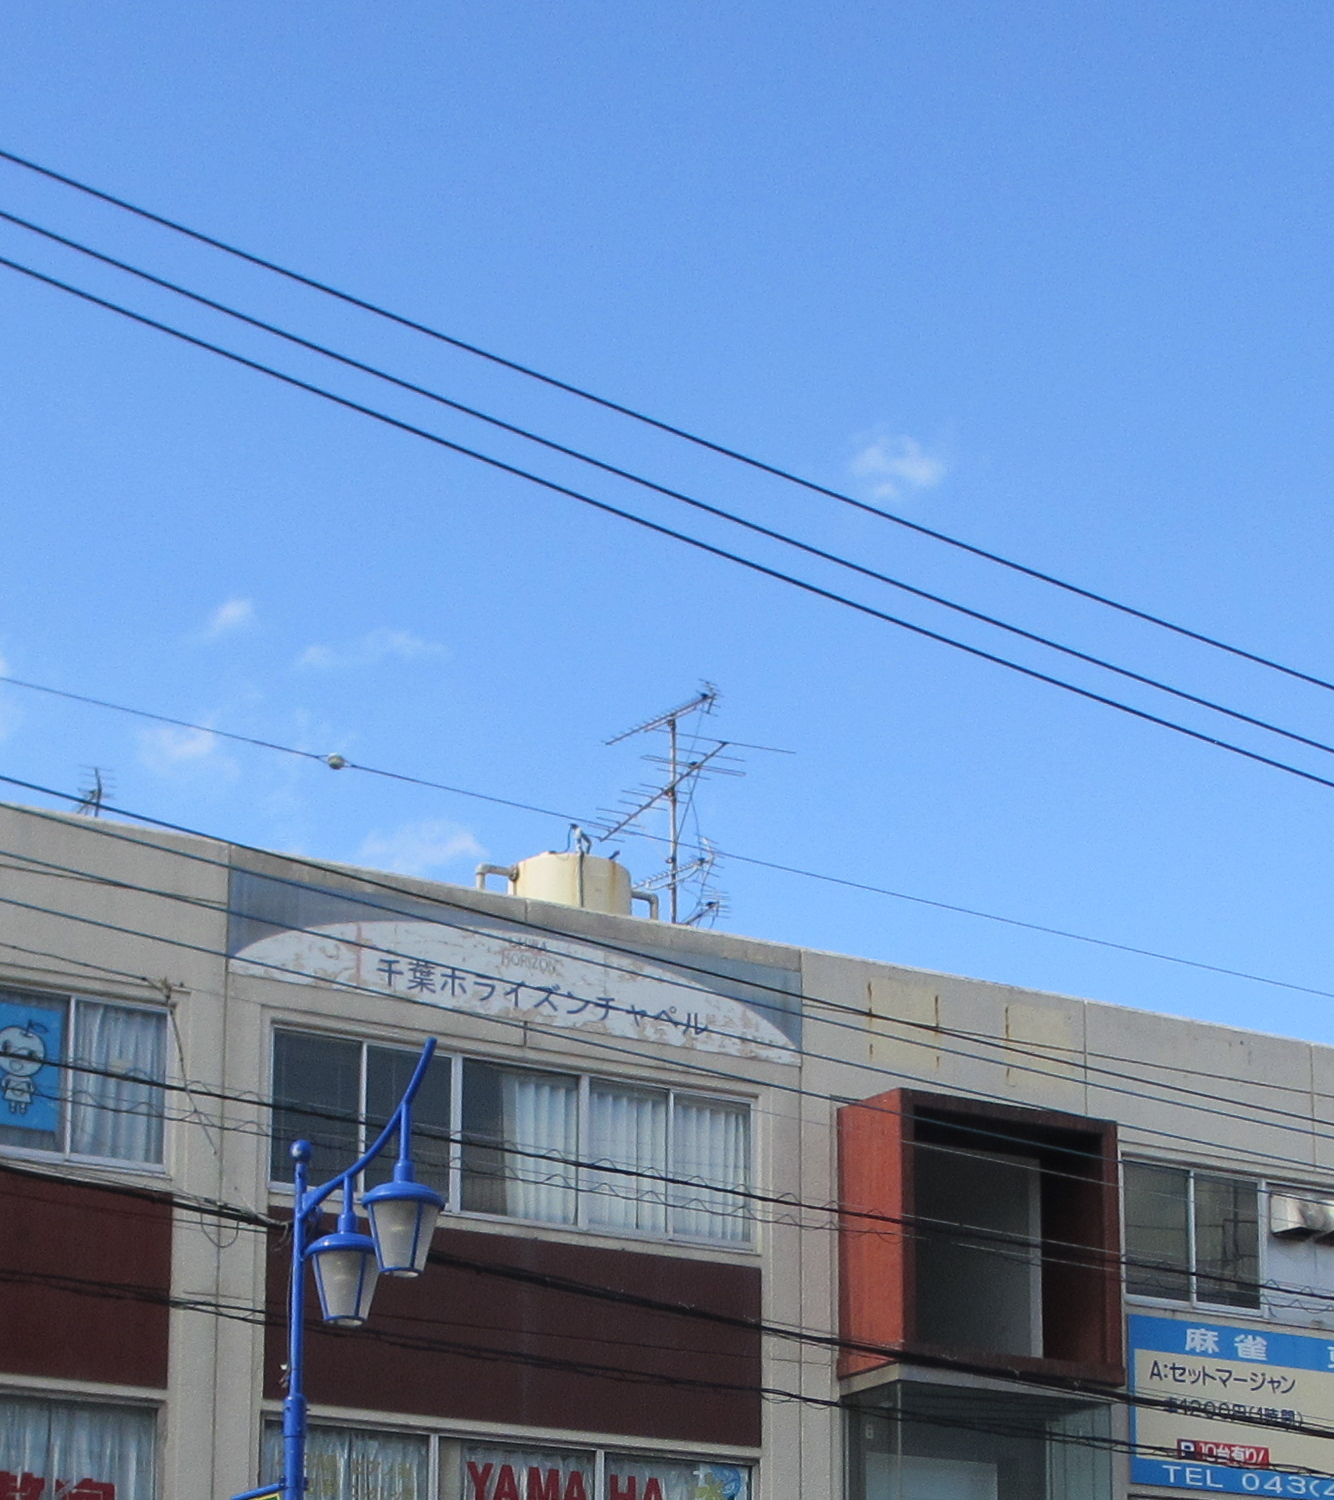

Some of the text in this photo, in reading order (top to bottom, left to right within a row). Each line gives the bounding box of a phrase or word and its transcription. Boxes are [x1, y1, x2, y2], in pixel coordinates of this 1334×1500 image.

[377, 959, 708, 1036] 千葉ホライズンチャペル
[1185, 1328, 1268, 1361] 麻雀
[1162, 1464, 1223, 1488] TEL
